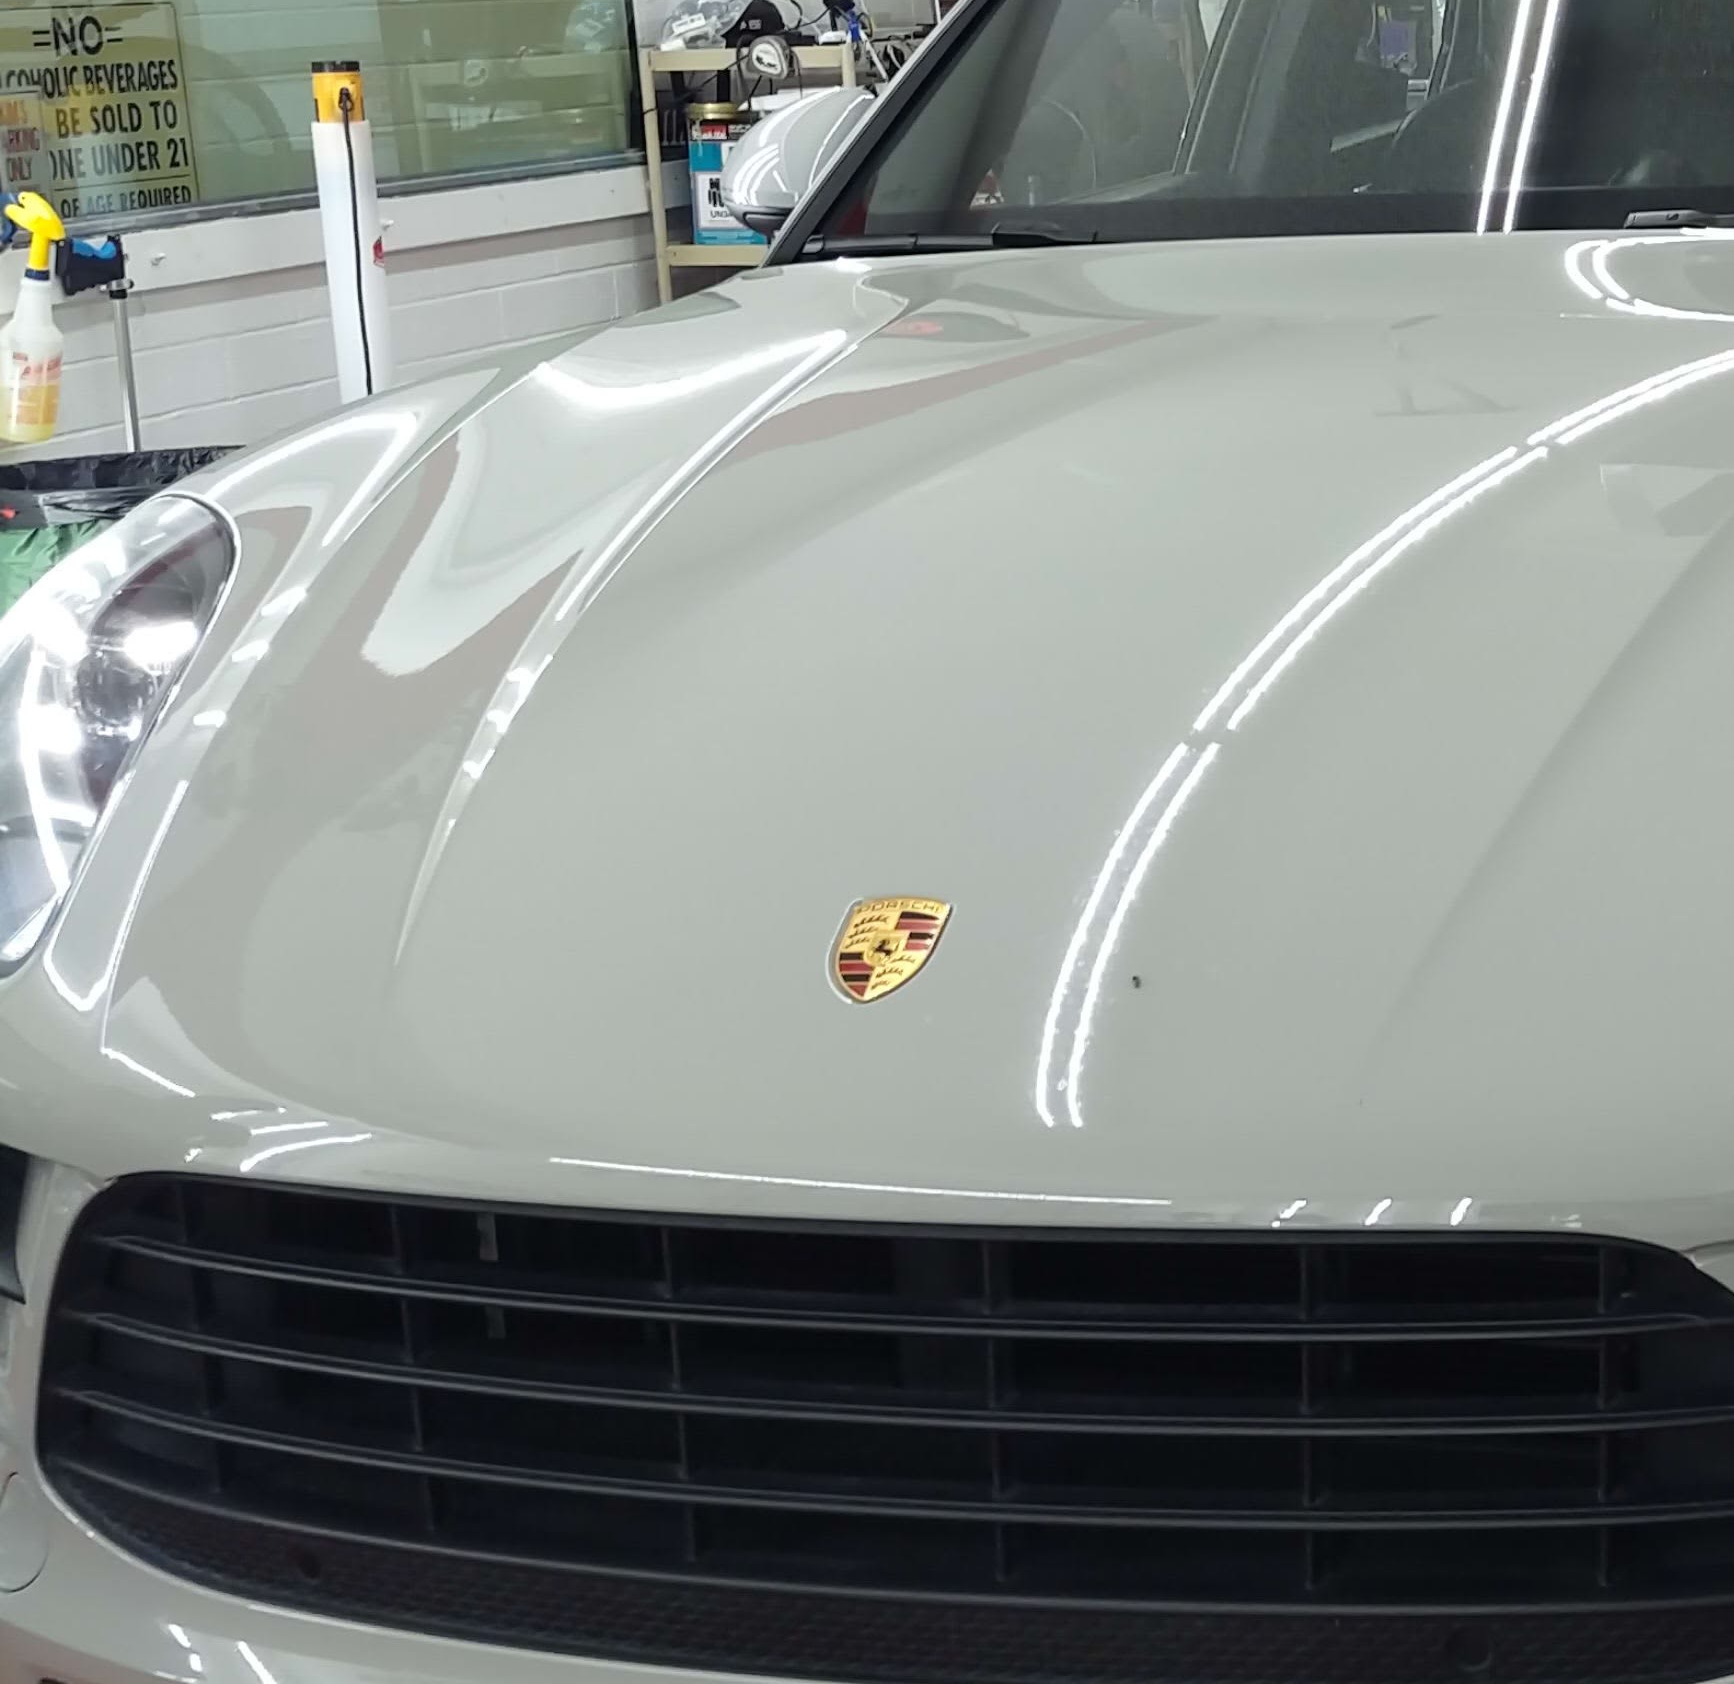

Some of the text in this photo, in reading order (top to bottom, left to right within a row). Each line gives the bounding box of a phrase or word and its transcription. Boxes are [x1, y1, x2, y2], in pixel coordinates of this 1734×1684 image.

[84, 59, 179, 96] BEVERAGES
[55, 107, 83, 139] BE
[89, 102, 143, 135] SOLD
[149, 99, 178, 131] TO
[91, 140, 161, 177] UNDER
[167, 137, 189, 167] 21
